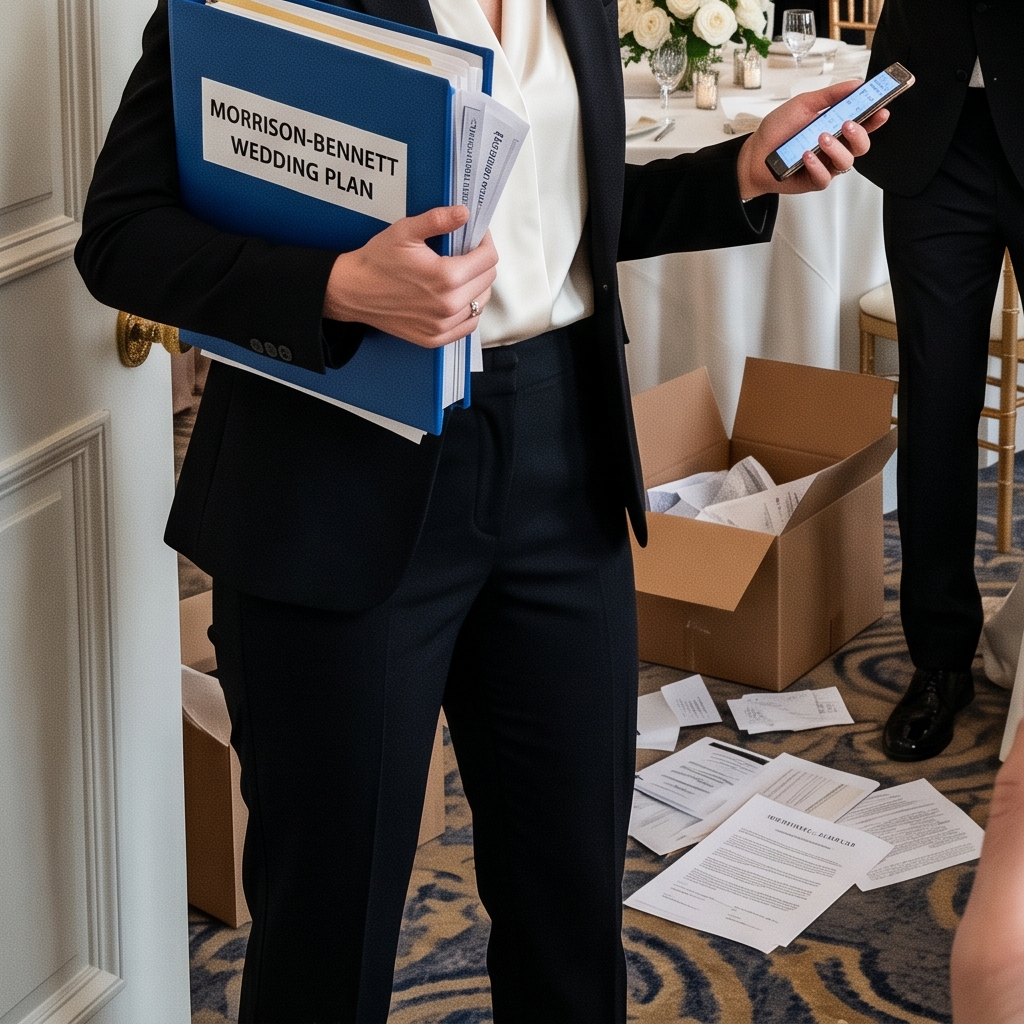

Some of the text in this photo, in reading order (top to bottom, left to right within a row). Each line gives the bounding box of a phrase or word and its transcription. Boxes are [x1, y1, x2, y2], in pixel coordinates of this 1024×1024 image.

[210, 98, 399, 176] MORRISON-BENNETT
[230, 135, 373, 201] WEDDING PLAN
